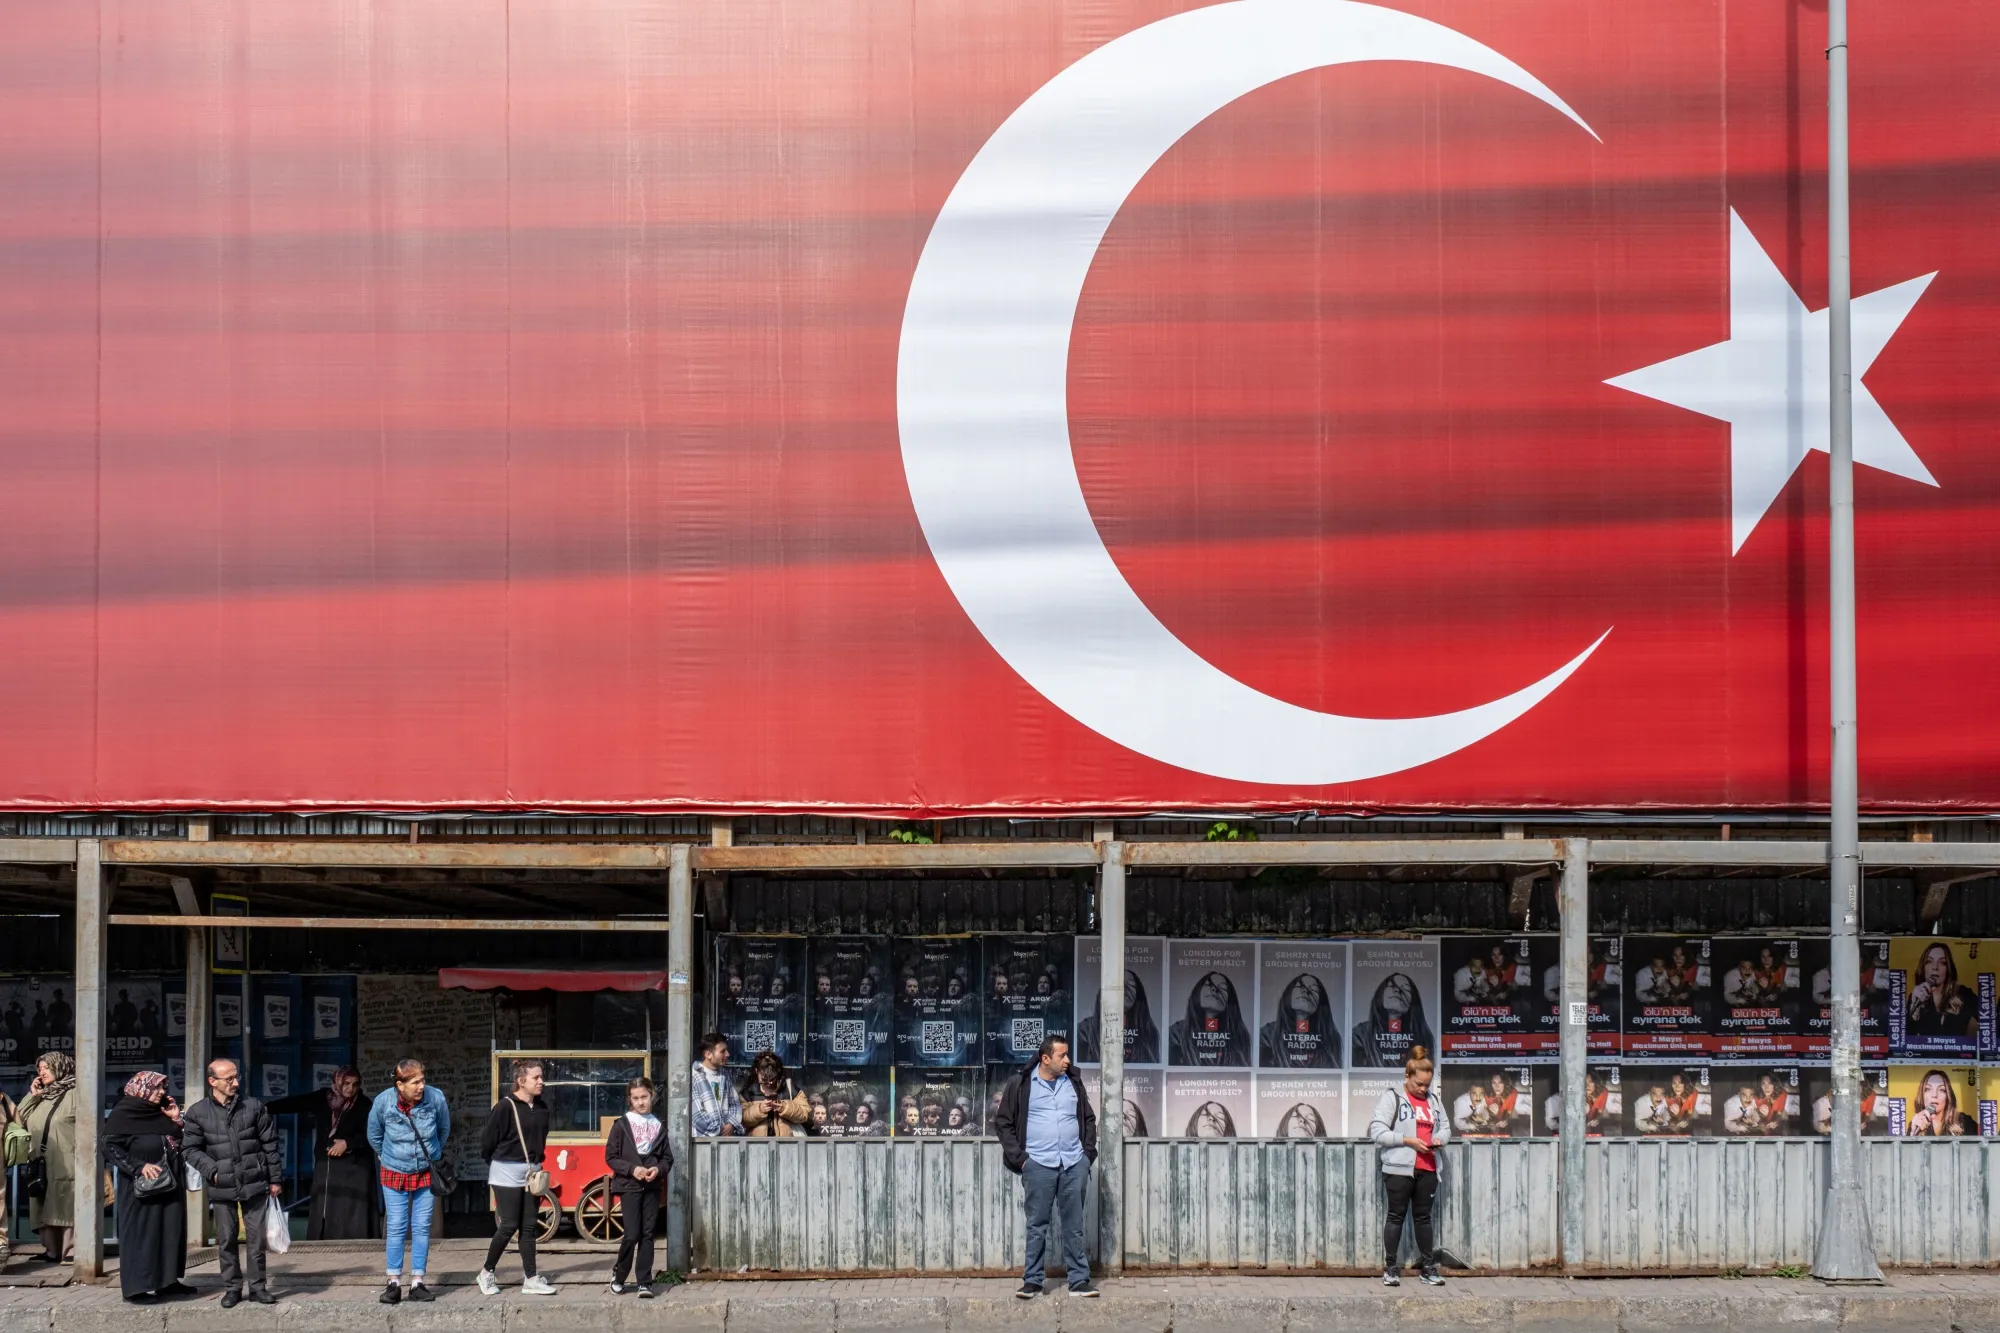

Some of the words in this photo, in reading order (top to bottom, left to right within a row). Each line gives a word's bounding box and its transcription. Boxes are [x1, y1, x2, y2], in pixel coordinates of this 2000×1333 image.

[1310, 951, 1332, 959] YENİ
[1401, 950, 1423, 958] YENİ
[1890, 972, 1901, 1016] Karavil
[1979, 975, 1991, 1019] Karavil
[1491, 1006, 1508, 1015] bizi
[1672, 1007, 1689, 1016] bizi
[1760, 1009, 1778, 1017] bizi
[1451, 1016, 1495, 1025] ayırana
[1498, 1014, 1521, 1024] dek
[1588, 1014, 1611, 1022] dek
[1632, 1016, 1676, 1025] ayırana
[1679, 1015, 1703, 1024] dek
[1721, 1018, 1765, 1027] ayırana
[1767, 1017, 1791, 1026] dek
[1808, 1018, 1831, 1027] ayır
[786, 1032, 799, 1041] MAY
[876, 1032, 888, 1041] MAY
[965, 1033, 977, 1041] MAY
[1375, 1033, 1414, 1041] LITERAL
[1889, 1019, 1900, 1048] Lesli
[1979, 1022, 1991, 1050] Lesli
[38, 1036, 74, 1049] RED
[106, 1036, 152, 1049] REDD
[1380, 1041, 1409, 1049] RADIO
[1306, 1080, 1328, 1088] YENİ
[1890, 1100, 1900, 1135] aravil
[1981, 1102, 1992, 1137] aravil
